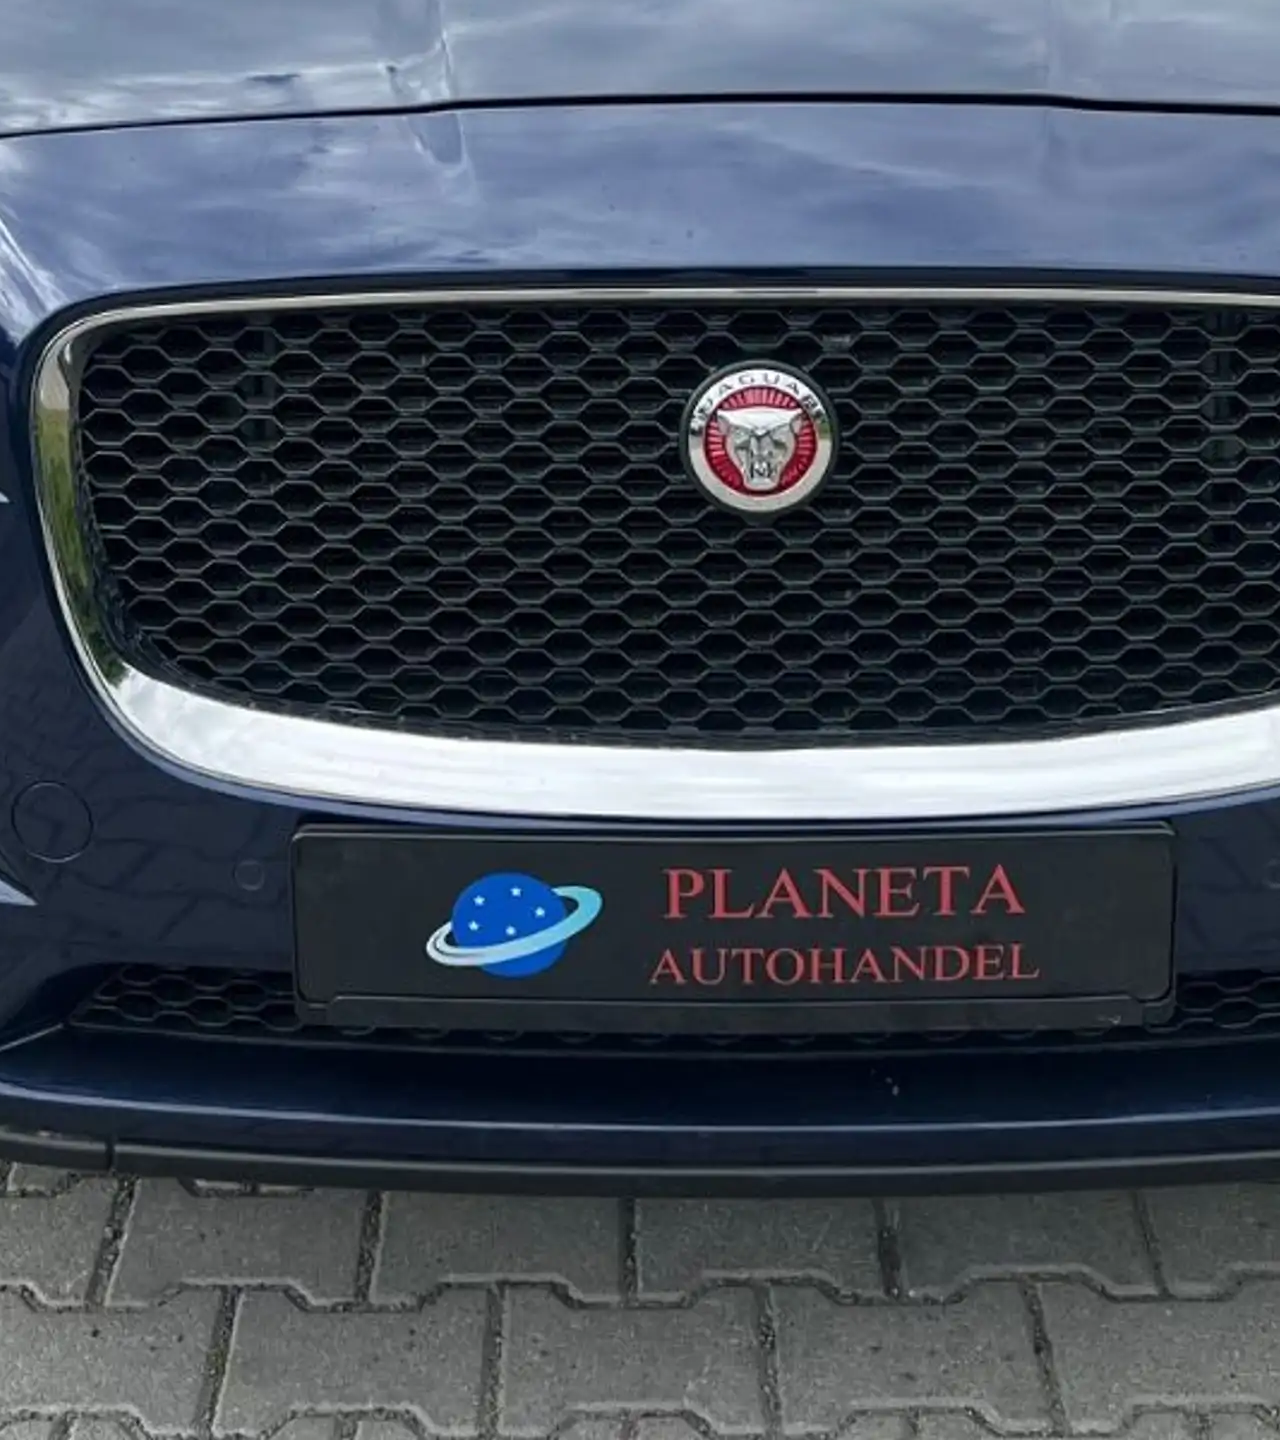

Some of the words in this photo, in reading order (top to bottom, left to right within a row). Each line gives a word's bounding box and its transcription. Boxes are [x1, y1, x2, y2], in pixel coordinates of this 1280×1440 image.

[702, 372, 819, 412] JAGUAR
[662, 863, 1027, 920] PLANETA
[650, 944, 1041, 985] AUTOHANDEL
